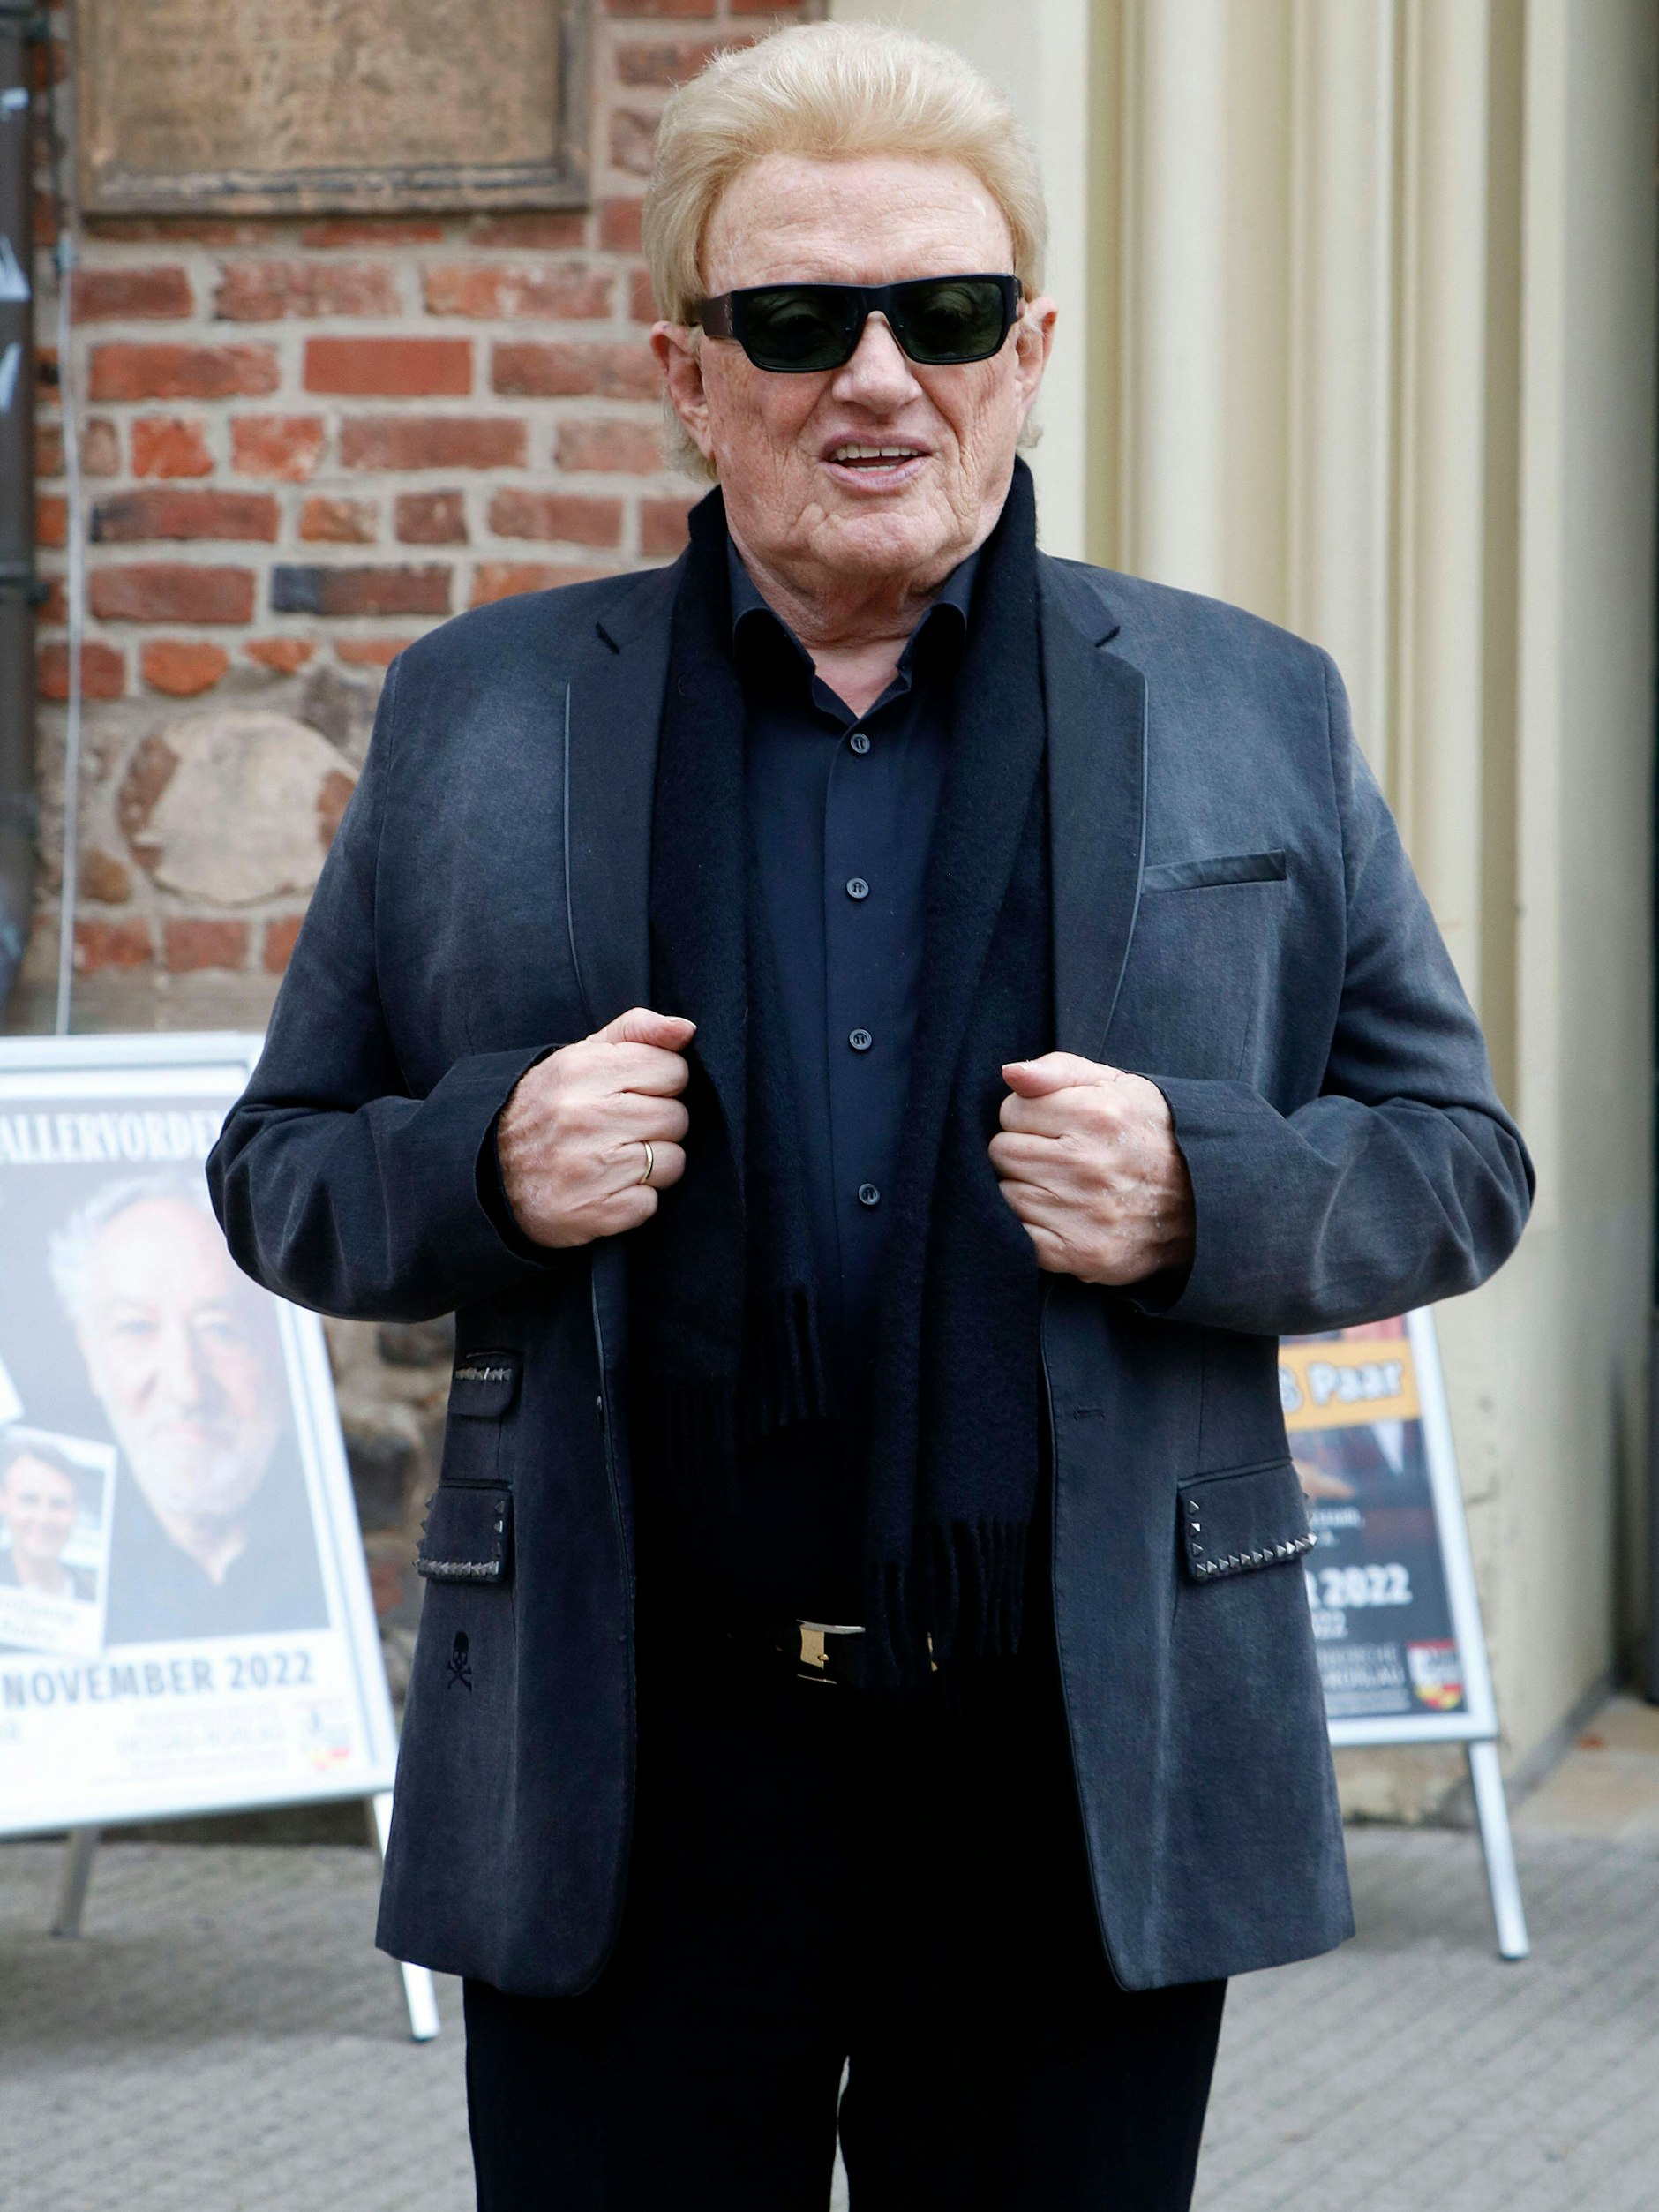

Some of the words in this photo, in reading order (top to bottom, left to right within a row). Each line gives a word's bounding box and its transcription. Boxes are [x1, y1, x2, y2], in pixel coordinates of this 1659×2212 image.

[1307, 1360, 1403, 1406] Paar
[1318, 1562, 1413, 1608] 2022
[1, 1657, 215, 1709] NOVEMBER
[225, 1648, 314, 1690] 2022
